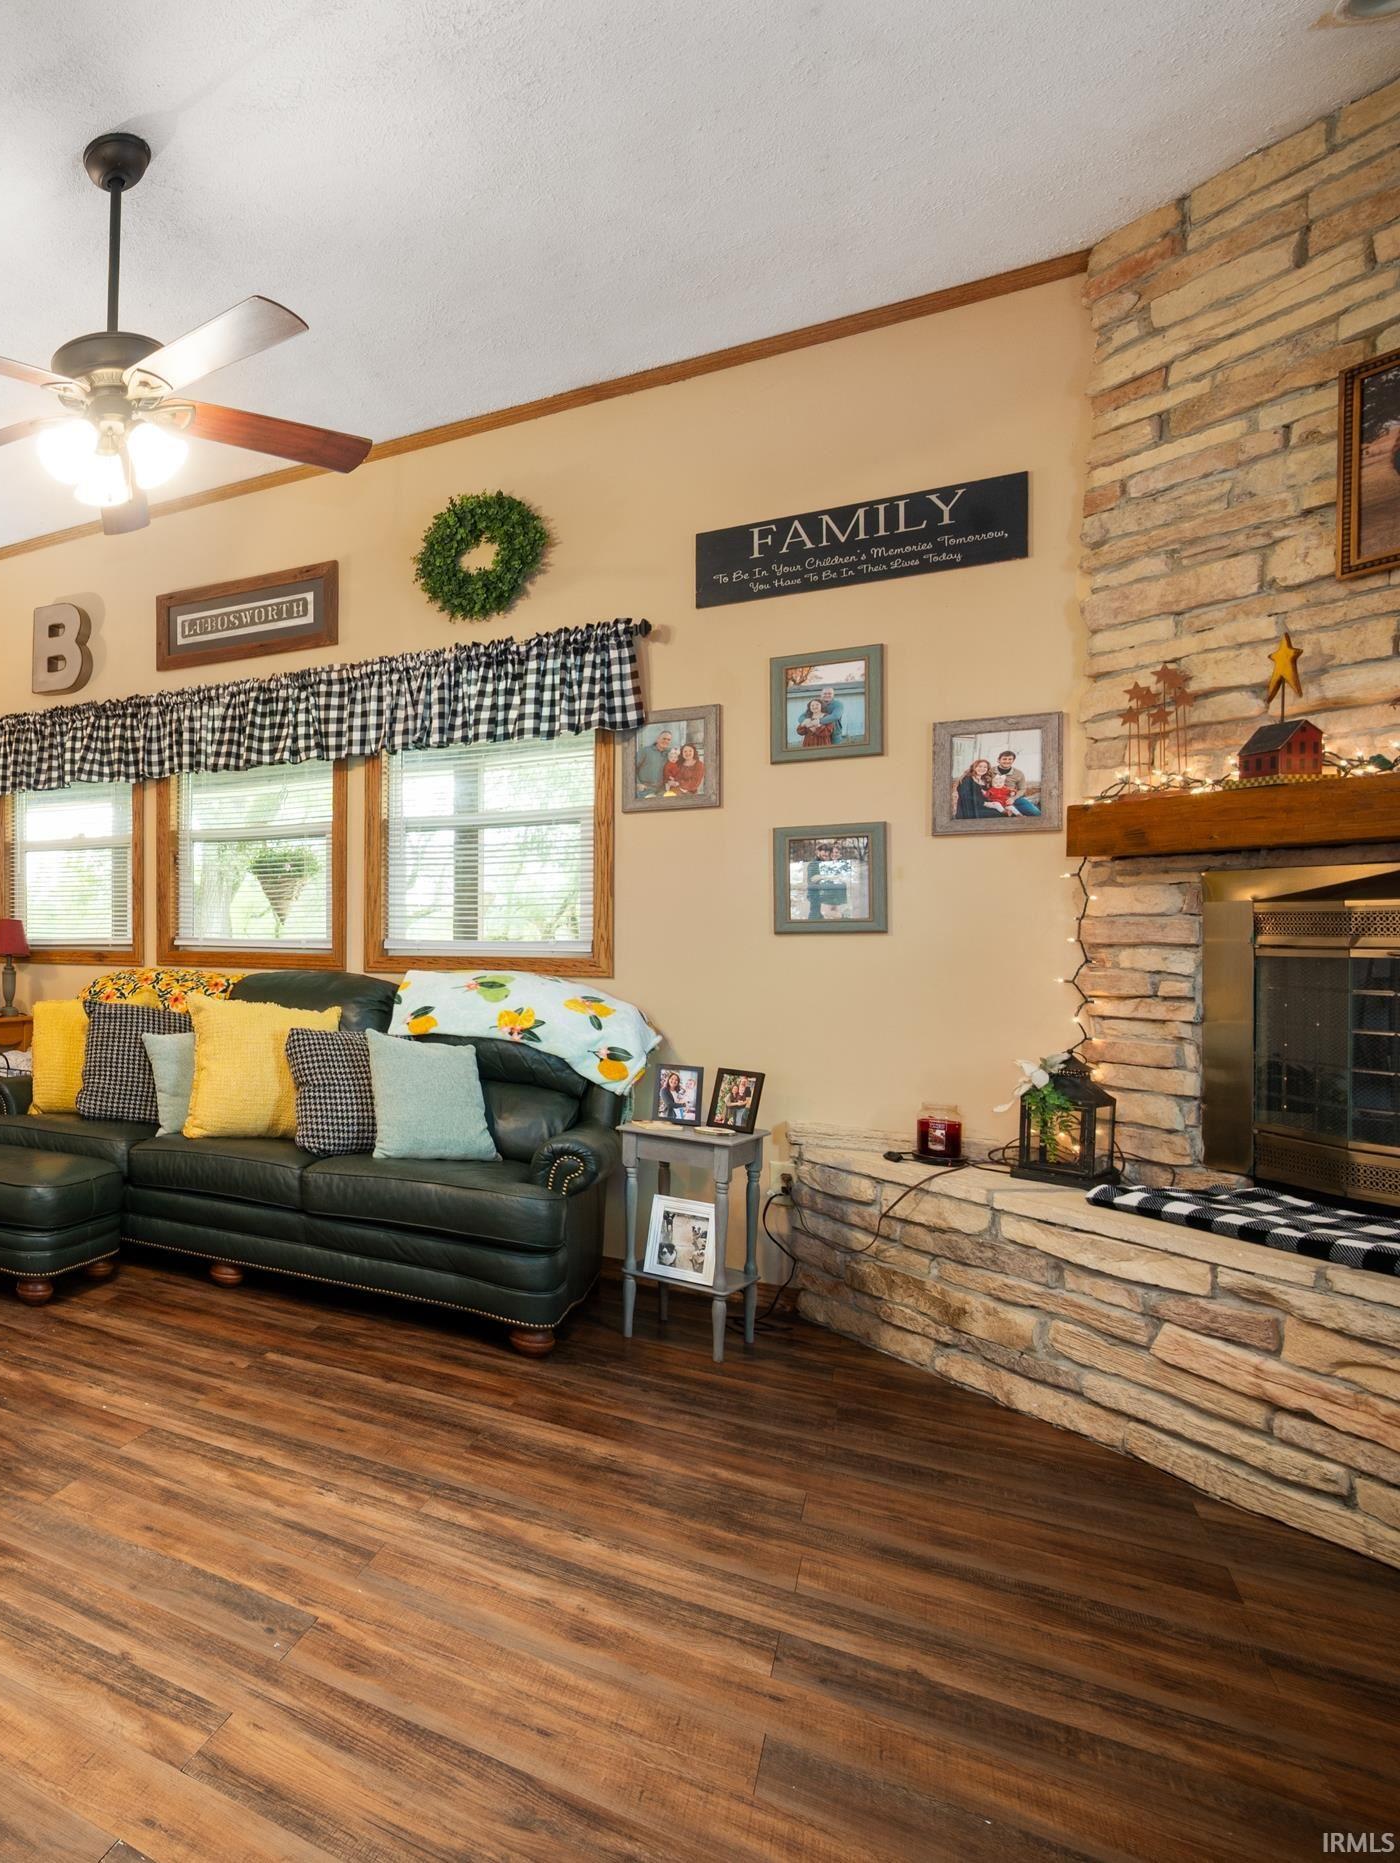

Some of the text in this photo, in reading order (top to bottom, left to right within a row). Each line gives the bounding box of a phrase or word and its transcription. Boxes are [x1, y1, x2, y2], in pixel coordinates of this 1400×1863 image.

[749, 488, 967, 559] FAMILY
[712, 529, 1009, 584] To Be In Your Children's Memories Tomorrow,
[749, 551, 963, 593] You Have To Be In Their Lives Today
[32, 603, 93, 696] B
